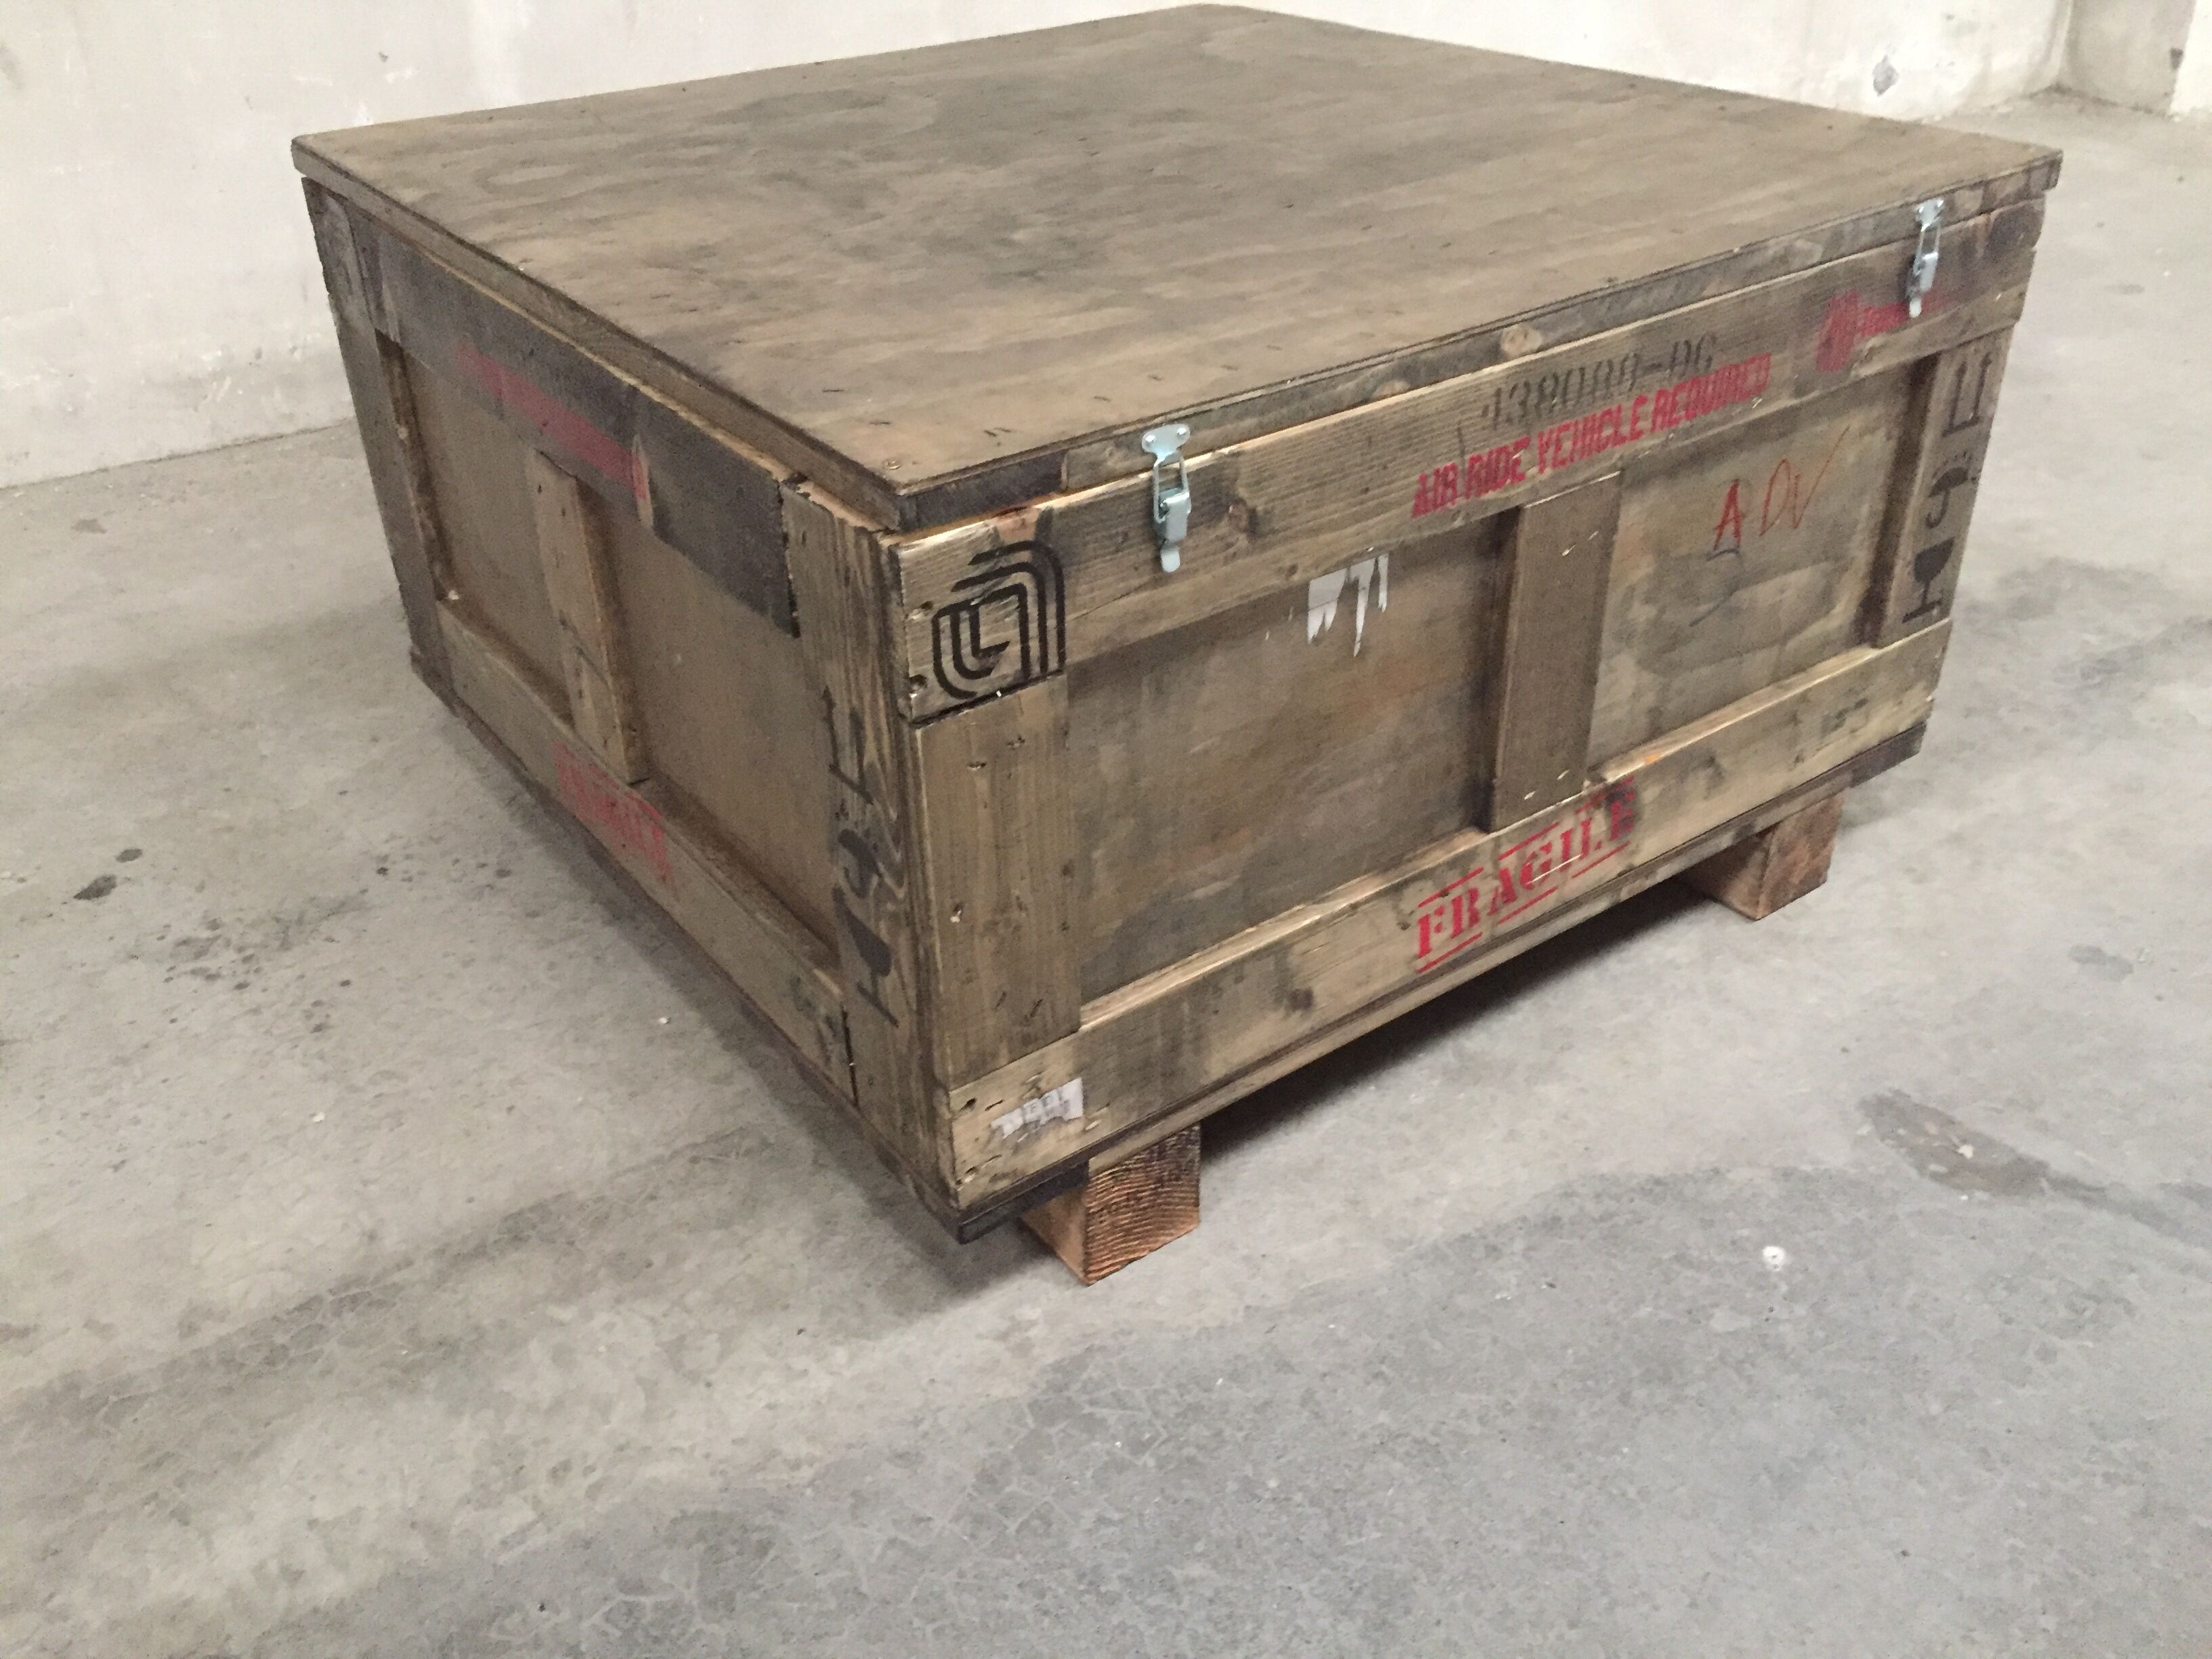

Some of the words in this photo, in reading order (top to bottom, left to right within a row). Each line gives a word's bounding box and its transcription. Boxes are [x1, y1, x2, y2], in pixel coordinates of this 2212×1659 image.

[1410, 462, 1458, 518] AIR
[1465, 436, 1530, 499] RIDE
[1538, 394, 1648, 474] VEHICLE
[1416, 789, 1637, 960] FRAGILE
